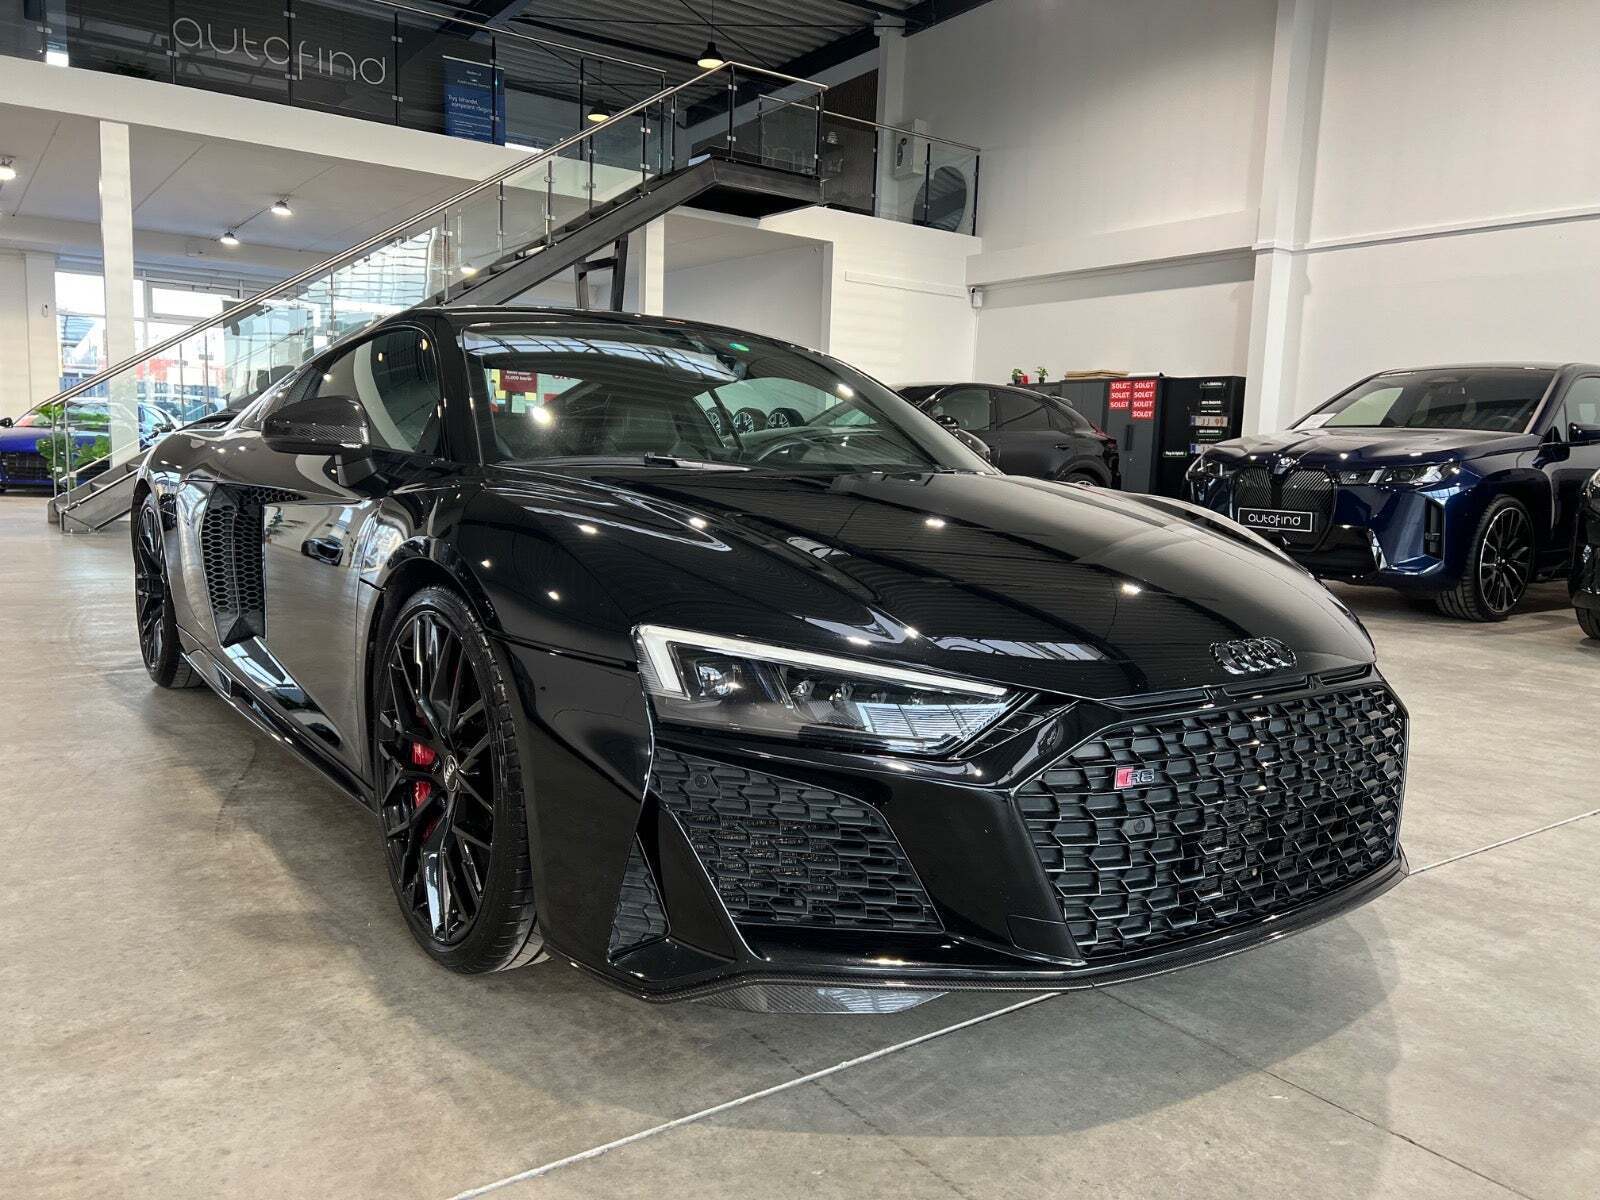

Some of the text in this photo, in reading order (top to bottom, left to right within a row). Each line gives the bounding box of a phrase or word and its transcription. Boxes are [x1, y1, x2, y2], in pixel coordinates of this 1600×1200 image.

[173, 17, 386, 85] autofind
[1111, 391, 1130, 399] SOLGT
[1248, 513, 1301, 527] autofind
